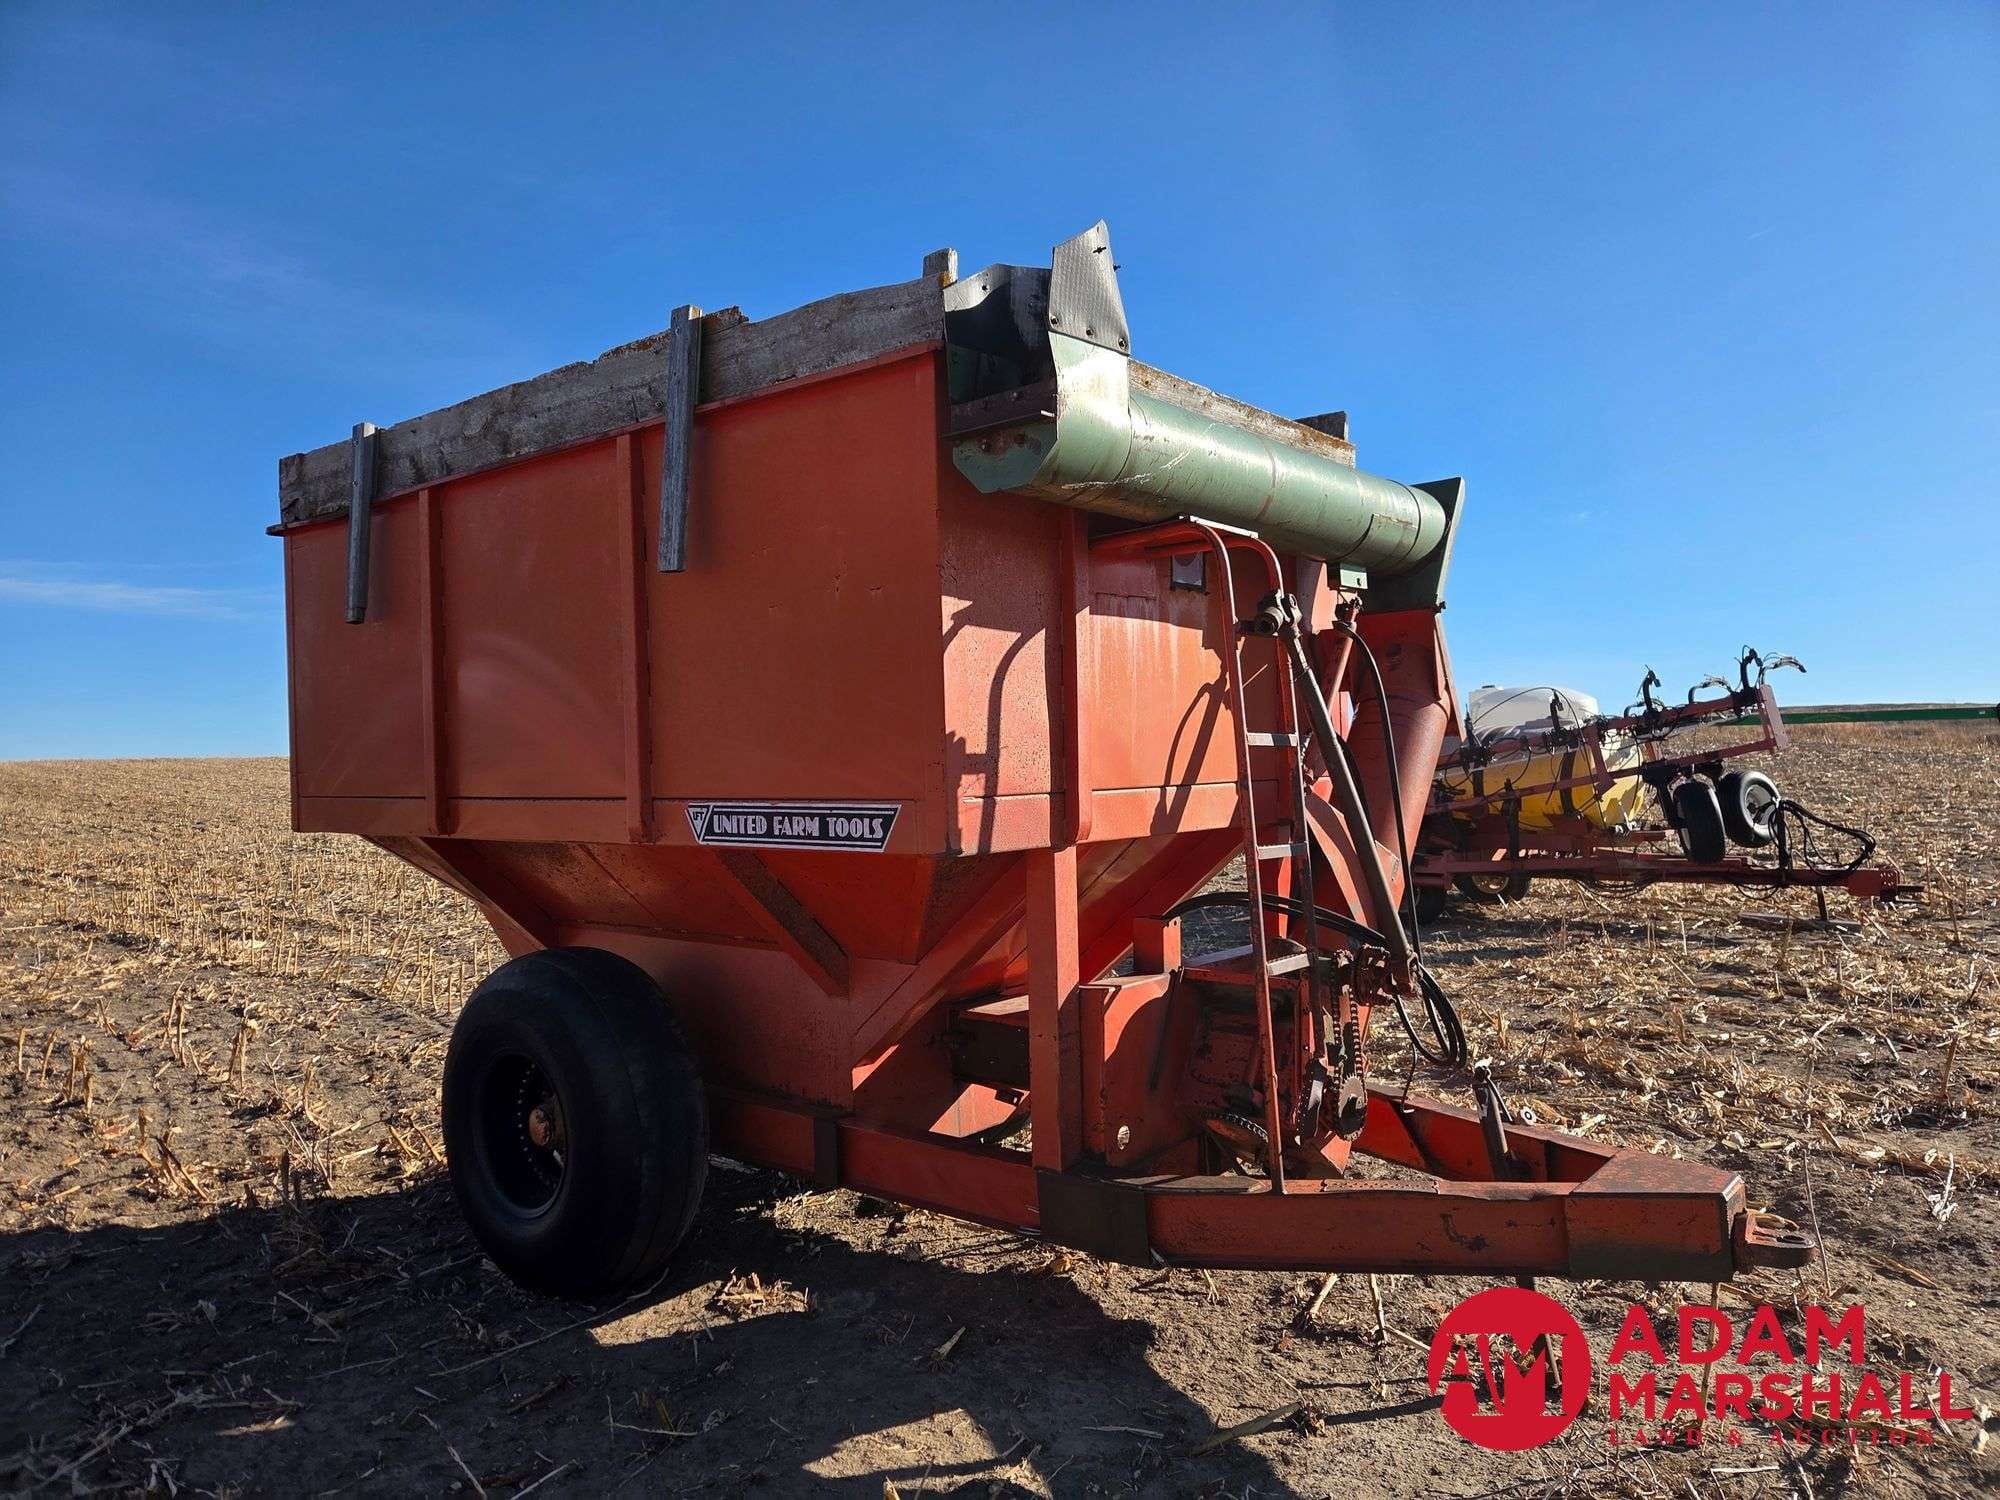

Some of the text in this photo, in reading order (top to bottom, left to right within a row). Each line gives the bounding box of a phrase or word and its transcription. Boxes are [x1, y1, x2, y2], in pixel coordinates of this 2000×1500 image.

[713, 813, 884, 839] UNITED FARM TOOLS
